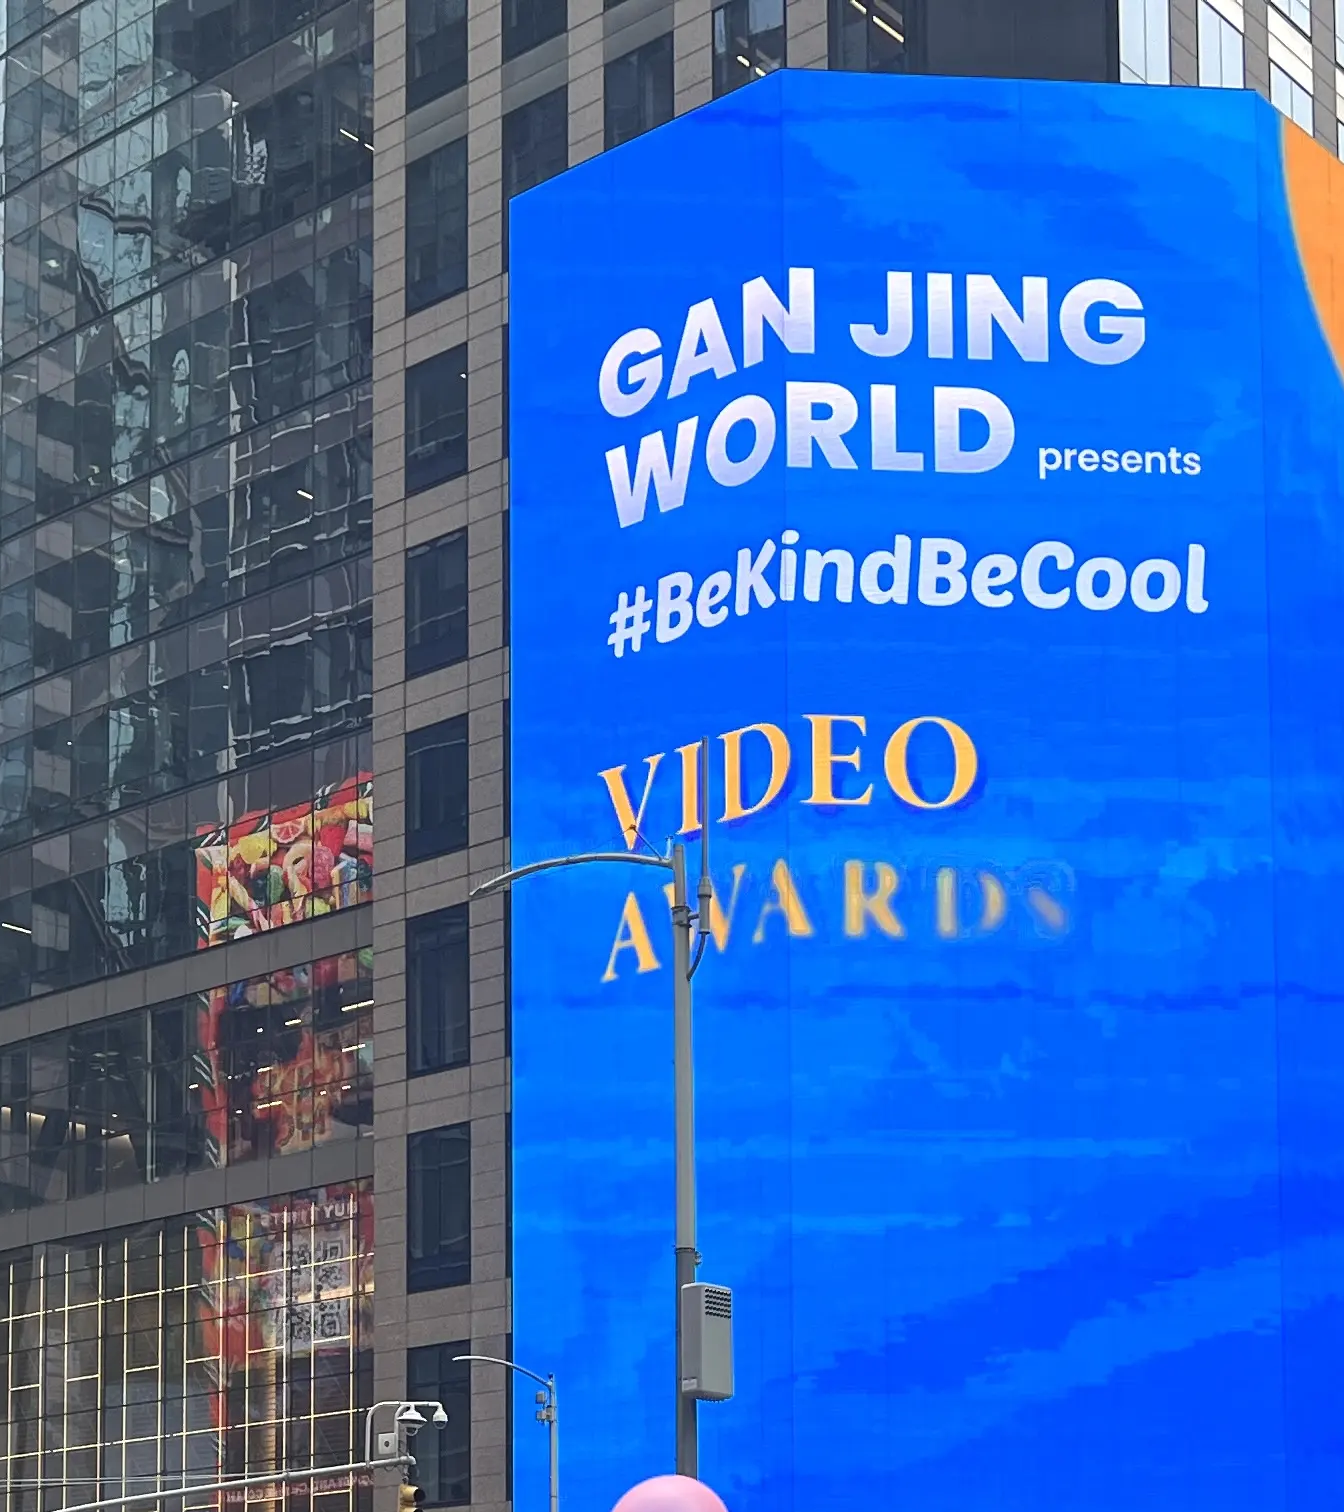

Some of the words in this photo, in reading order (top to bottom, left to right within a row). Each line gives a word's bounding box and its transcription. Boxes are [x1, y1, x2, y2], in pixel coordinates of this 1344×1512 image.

[599, 268, 815, 418] GAN
[850, 270, 1146, 366] JING
[605, 381, 1016, 528] WORLD
[1038, 443, 1202, 479] presents
[607, 530, 1209, 659] #BeKindBeCool
[598, 714, 982, 850] VIDEO
